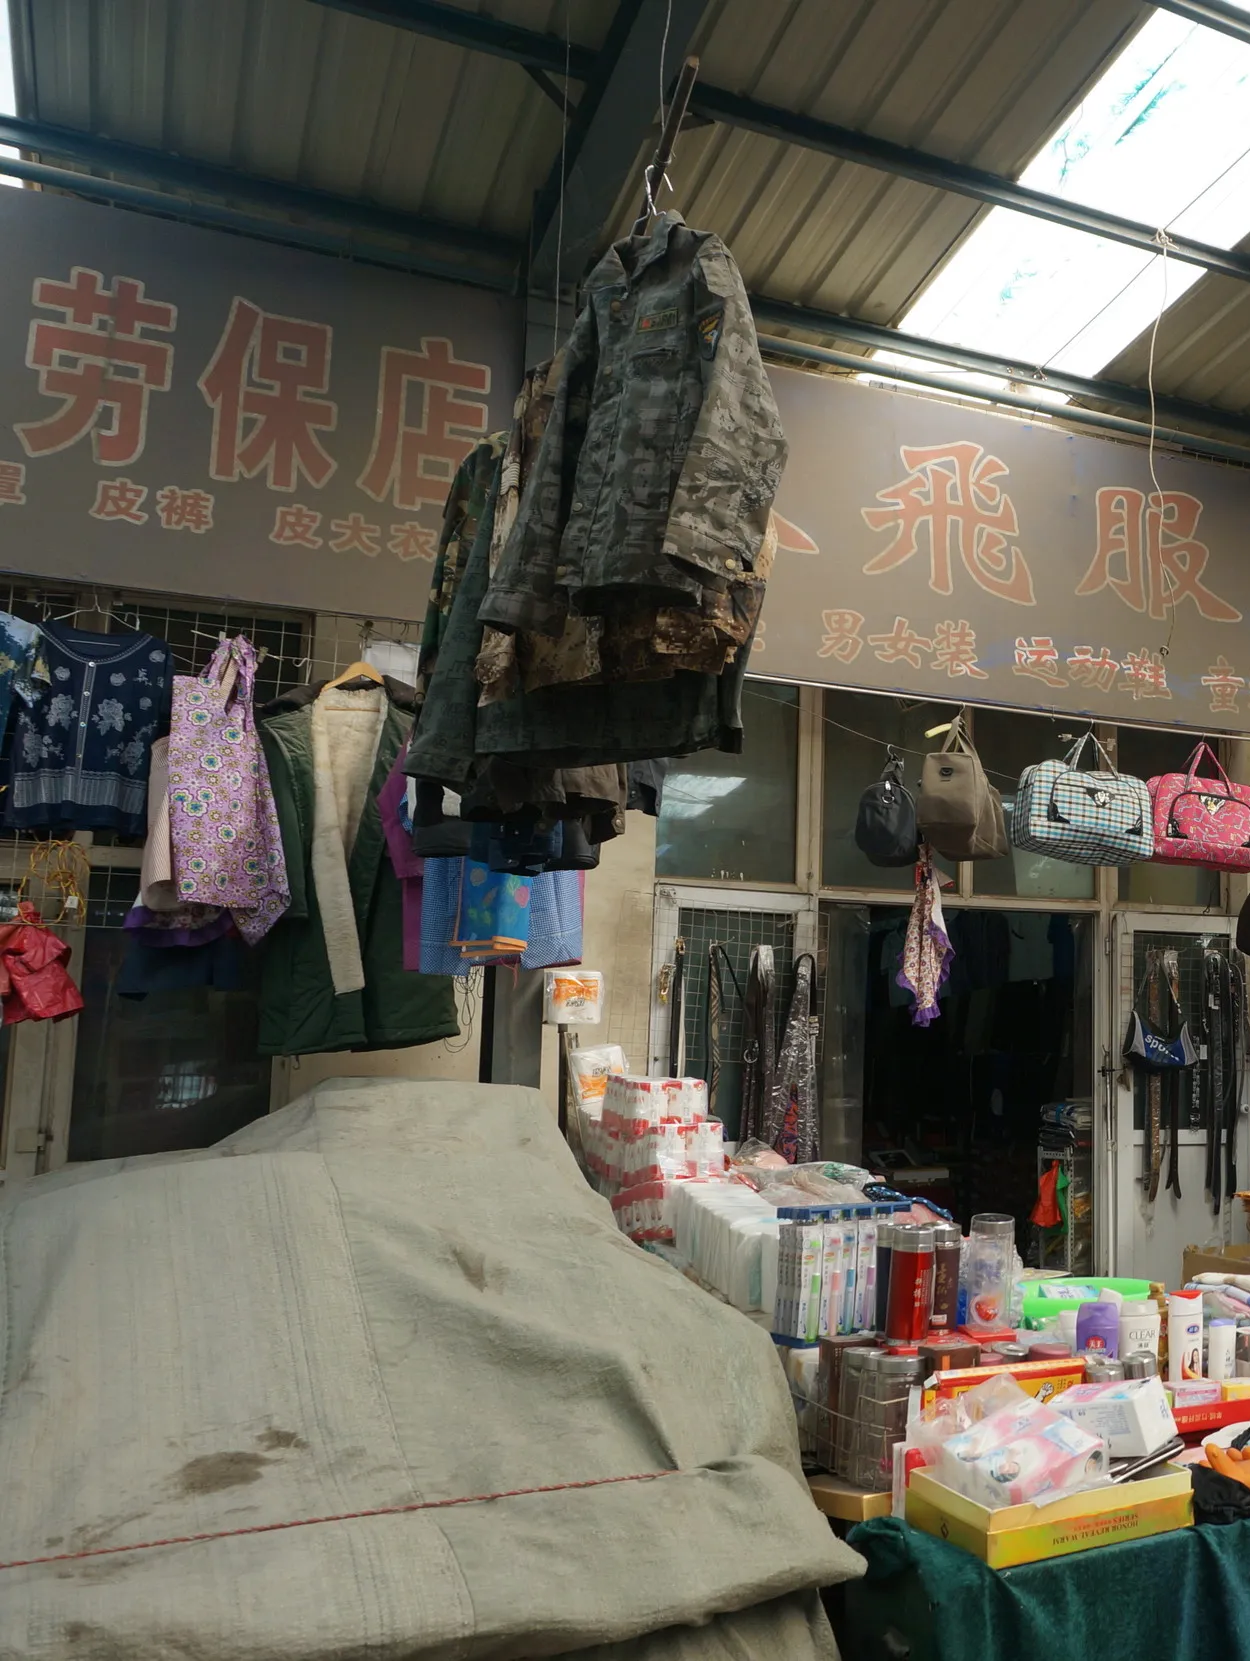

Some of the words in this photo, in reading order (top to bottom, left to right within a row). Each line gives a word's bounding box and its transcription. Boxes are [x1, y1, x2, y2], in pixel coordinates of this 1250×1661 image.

[13, 266, 491, 510] 劳保店
[89, 478, 214, 534] 皮裤
[269, 505, 438, 562] 皮大衣
[817, 608, 987, 680] 男女装
[1012, 635, 1172, 700] 运动鞋
[1129, 1329, 1156, 1341] CLEAR
[1111, 1520, 1139, 1532] HONOR
